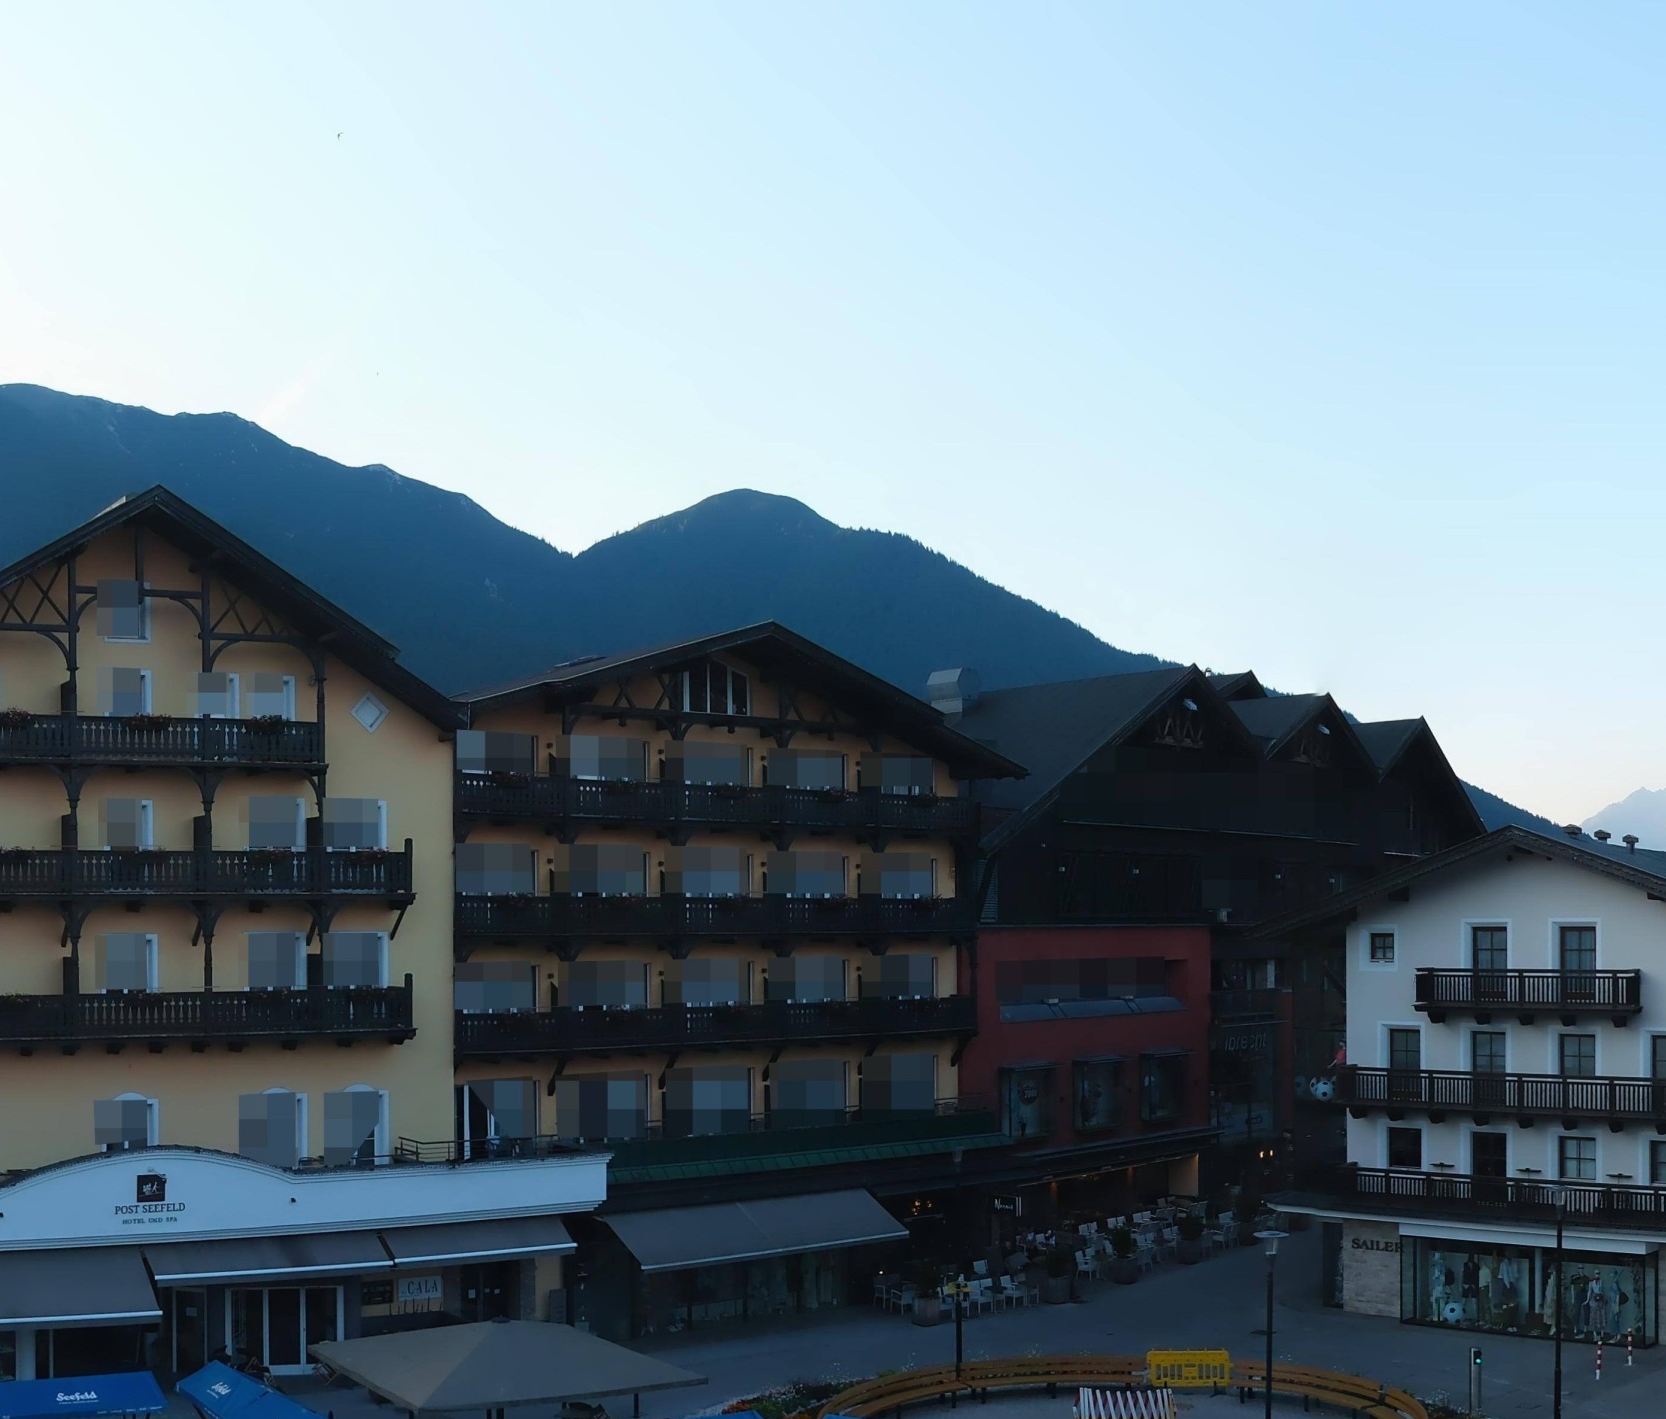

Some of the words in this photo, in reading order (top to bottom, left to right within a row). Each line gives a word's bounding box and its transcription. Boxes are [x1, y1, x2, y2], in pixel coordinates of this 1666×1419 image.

[114, 1205, 139, 1215] POST
[142, 1202, 185, 1214] SEEFELD
[122, 1217, 145, 1225] HOTEL
[1352, 1238, 1403, 1253] SAILER
[56, 1390, 98, 1402] Seefeld
